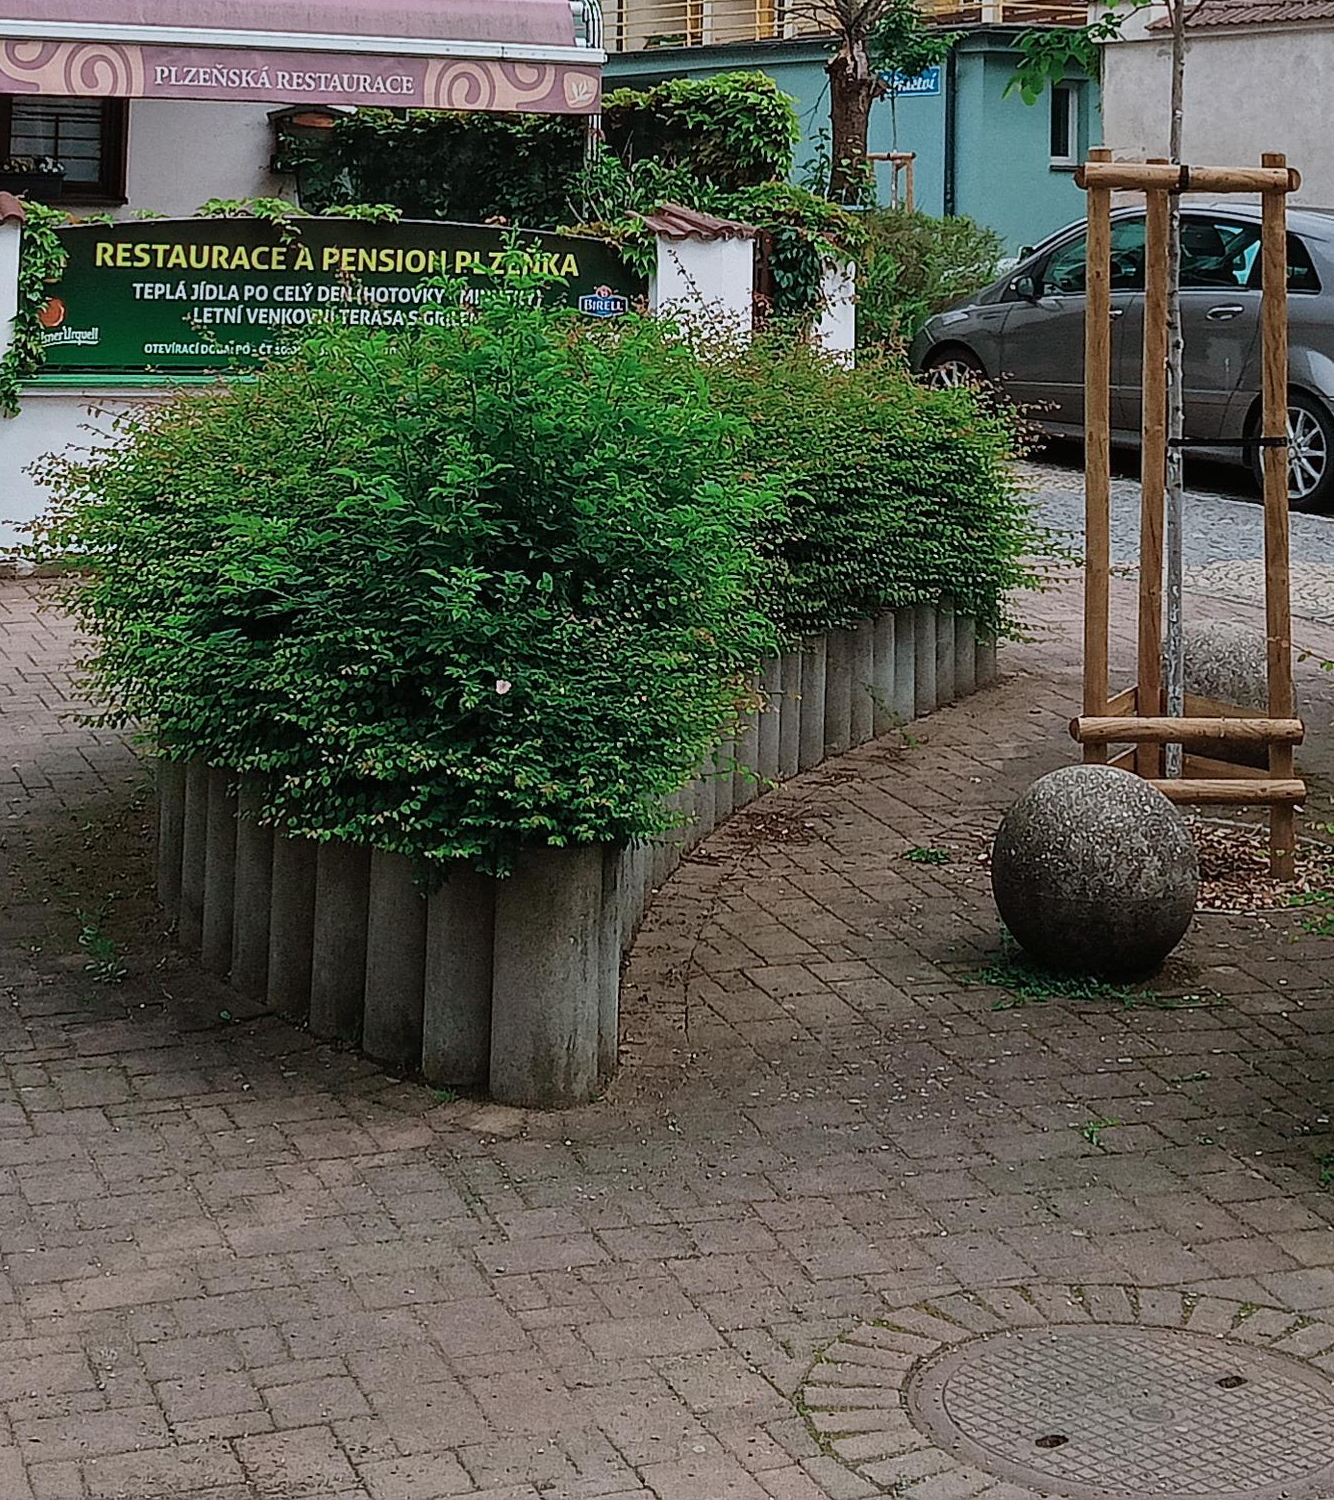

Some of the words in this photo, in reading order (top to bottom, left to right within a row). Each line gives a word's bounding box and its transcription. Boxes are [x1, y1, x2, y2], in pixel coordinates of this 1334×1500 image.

[154, 64, 272, 88] PLZEŇSKÁ
[275, 71, 415, 94] RESTAURACE
[94, 242, 287, 270] RESTAURACE
[294, 247, 315, 270] A
[322, 247, 447, 274] PENSION
[132, 281, 187, 300] TEPLÁ
[190, 281, 240, 301] JÍDLA
[244, 285, 268, 301] PO
[273, 283, 313, 302] CELÝ
[317, 286, 353, 302] DEN
[193, 305, 244, 324] LETNÍ
[338, 308, 405, 326] TERASA
[584, 299, 624, 311] BIRELL
[62, 326, 99, 346] Urquell
[144, 341, 199, 355] OTEVÍRACÍ
